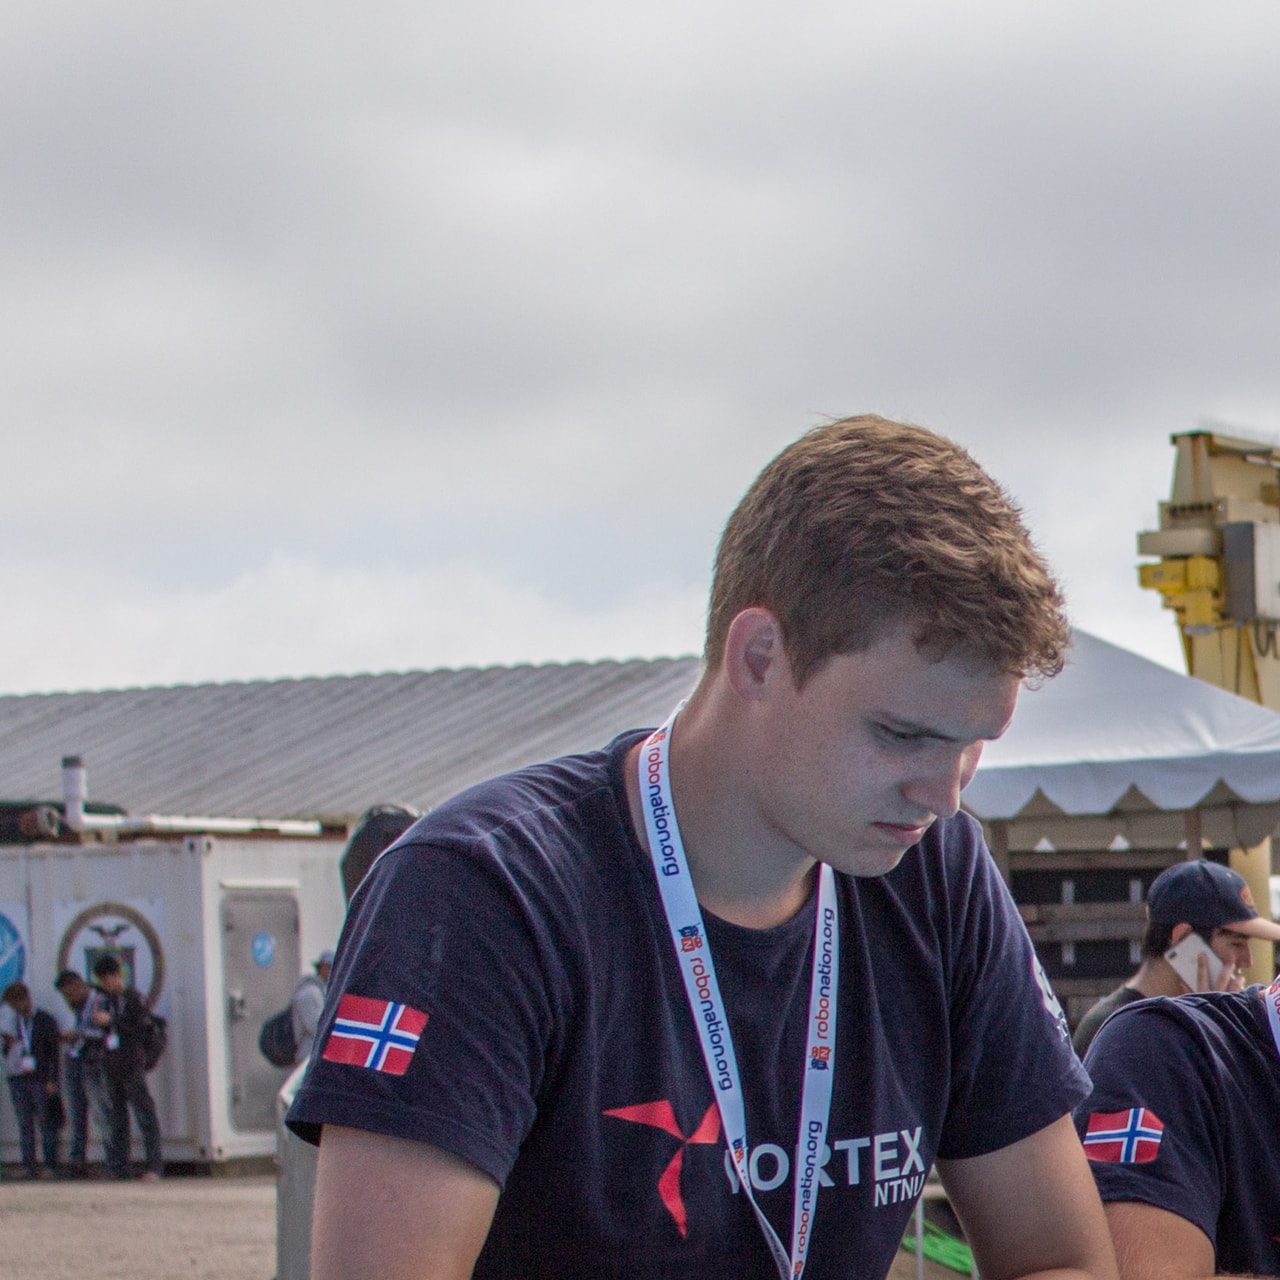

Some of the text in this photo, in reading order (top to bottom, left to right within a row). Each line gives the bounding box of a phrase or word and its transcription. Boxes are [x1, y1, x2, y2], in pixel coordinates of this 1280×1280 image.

[648, 746, 679, 877] robonation.org
[690, 956, 733, 1091] robonation.org
[815, 908, 835, 1039] robonation.org
[798, 1121, 823, 1254] robonation.org
[874, 1174, 926, 1208] NTNU
